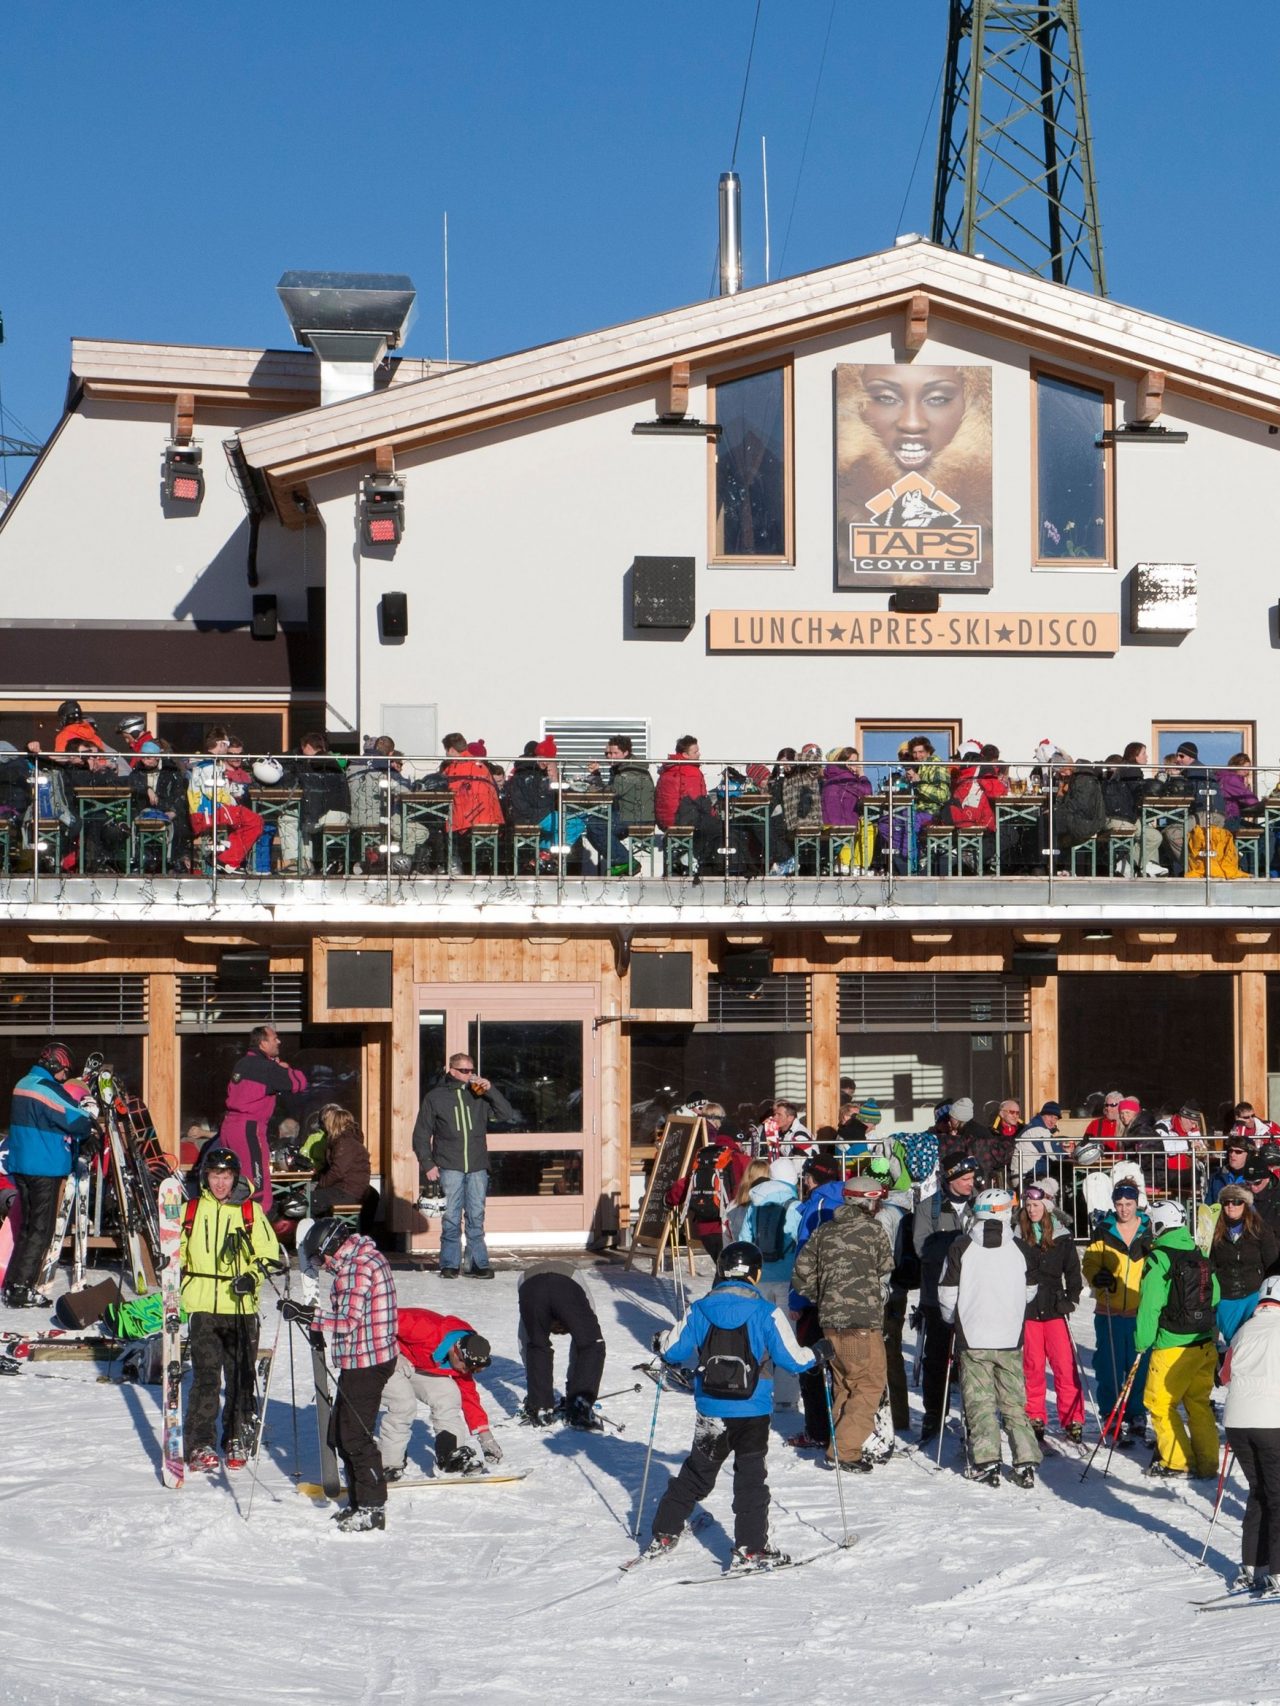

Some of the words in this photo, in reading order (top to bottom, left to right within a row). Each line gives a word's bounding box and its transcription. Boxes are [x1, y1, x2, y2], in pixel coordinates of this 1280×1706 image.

[857, 530, 975, 557] TAPS
[859, 559, 972, 571] COYOTES
[733, 616, 823, 645] LUNCH
[849, 617, 990, 646] APRES-SKI
[1018, 618, 1097, 647] DISCO
